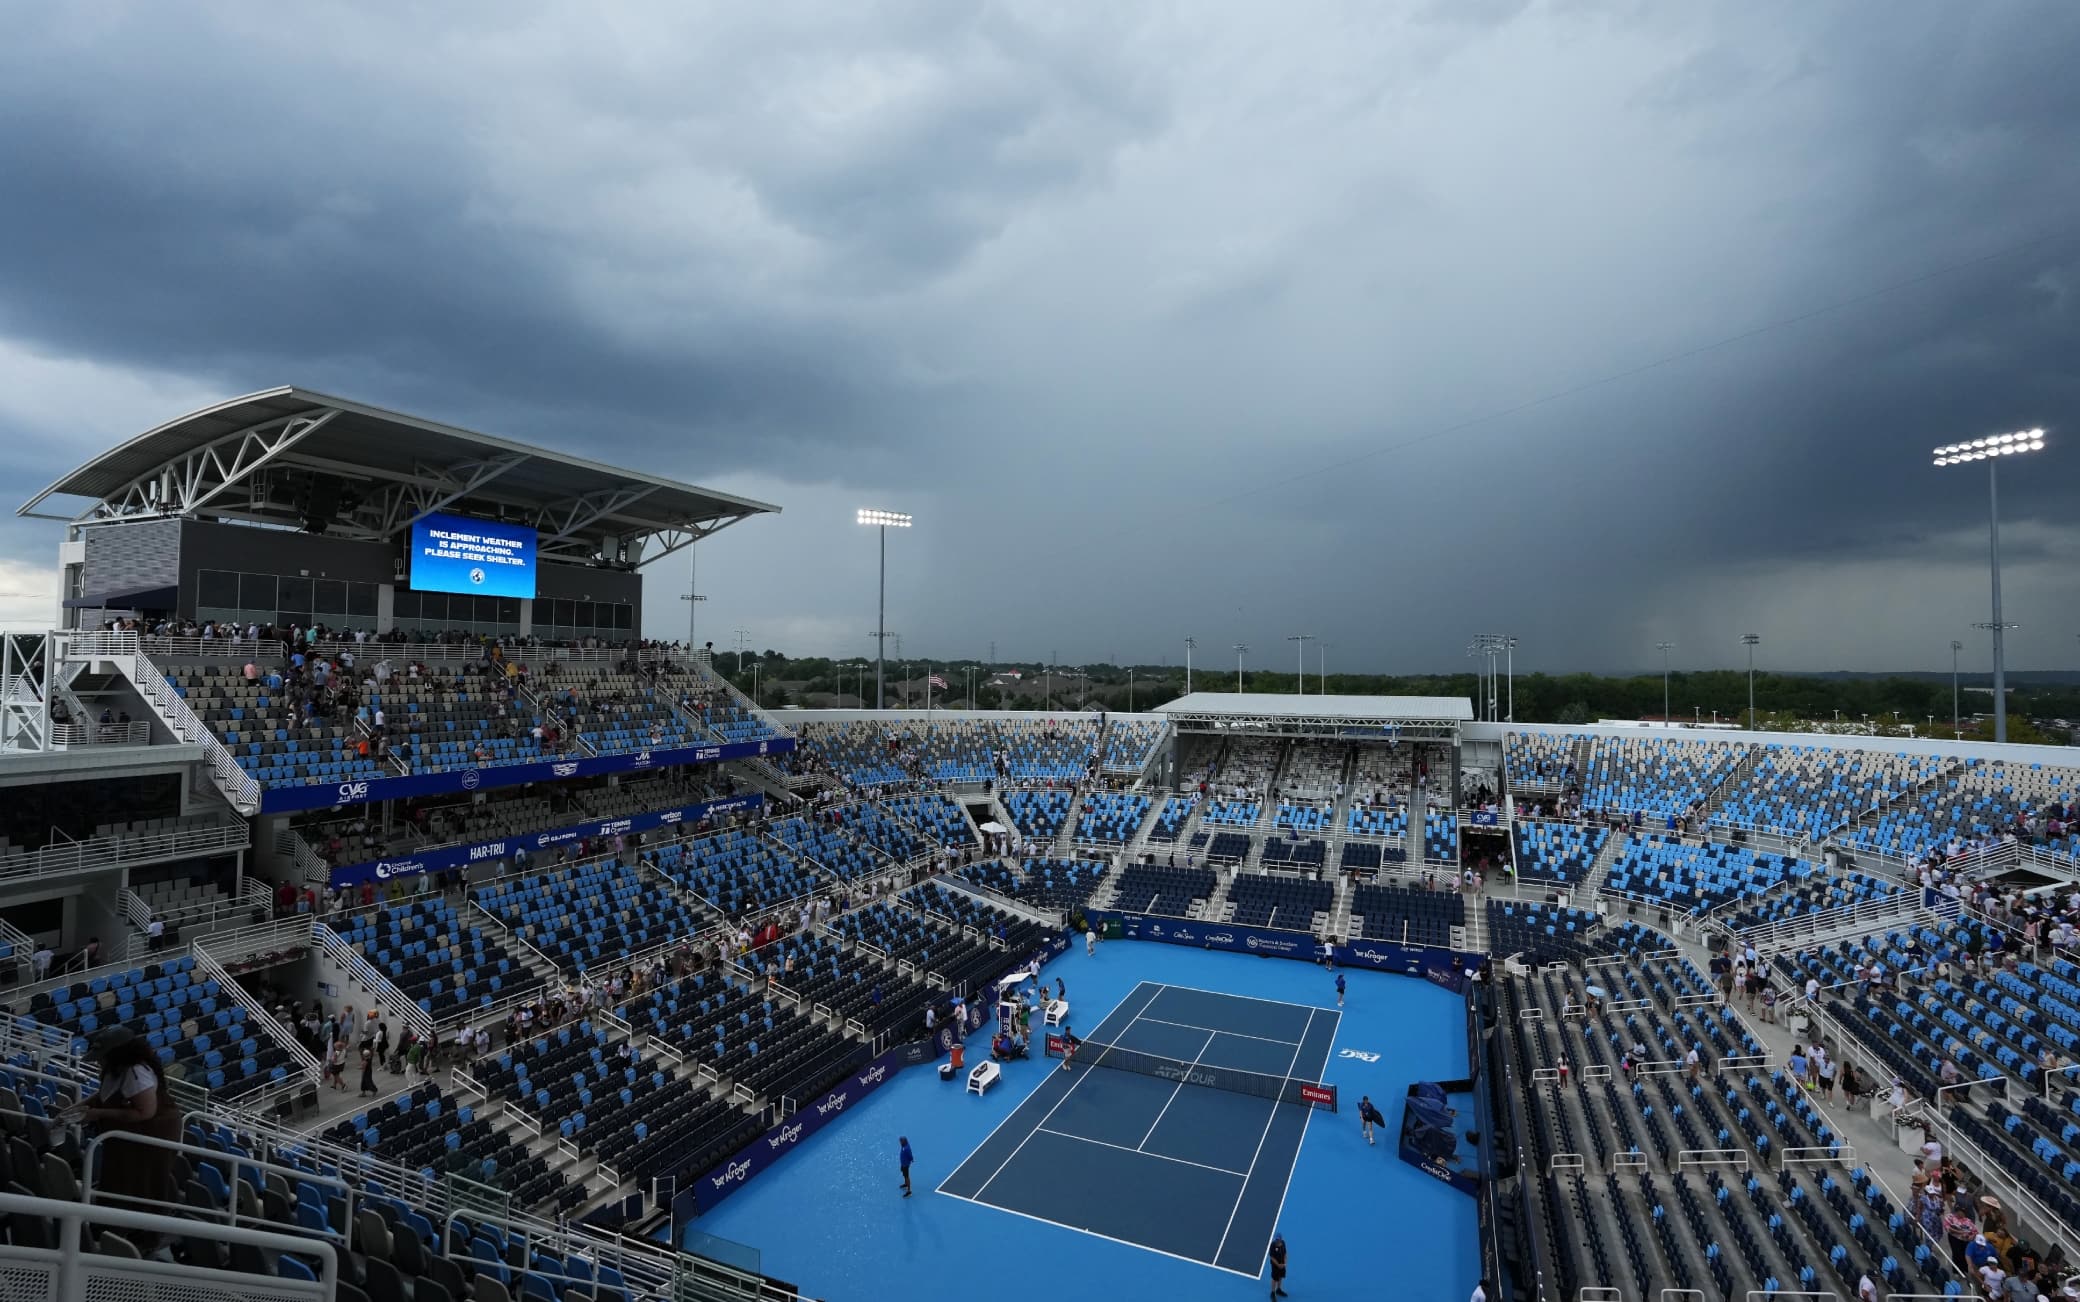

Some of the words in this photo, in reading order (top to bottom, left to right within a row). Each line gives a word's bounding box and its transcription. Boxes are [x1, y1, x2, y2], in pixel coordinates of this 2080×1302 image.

[430, 530, 480, 543] INCLEMENT
[482, 537, 522, 549] WEATHER
[425, 548, 461, 559] PLEASE
[462, 553, 485, 562] SEEK
[486, 555, 525, 566] SHELTER.
[450, 542, 514, 556] APPROACHING.
[339, 783, 367, 795] CVG
[660, 812, 682, 820] verizon
[470, 843, 505, 860] HAR-TRU
[1364, 950, 1389, 963] Kroger
[868, 1066, 885, 1083] Kroger
[827, 1093, 847, 1111] Kroger
[1302, 1088, 1331, 1100] Emirates
[780, 1123, 802, 1143] Kroger
[725, 1159, 752, 1182] Kroger
